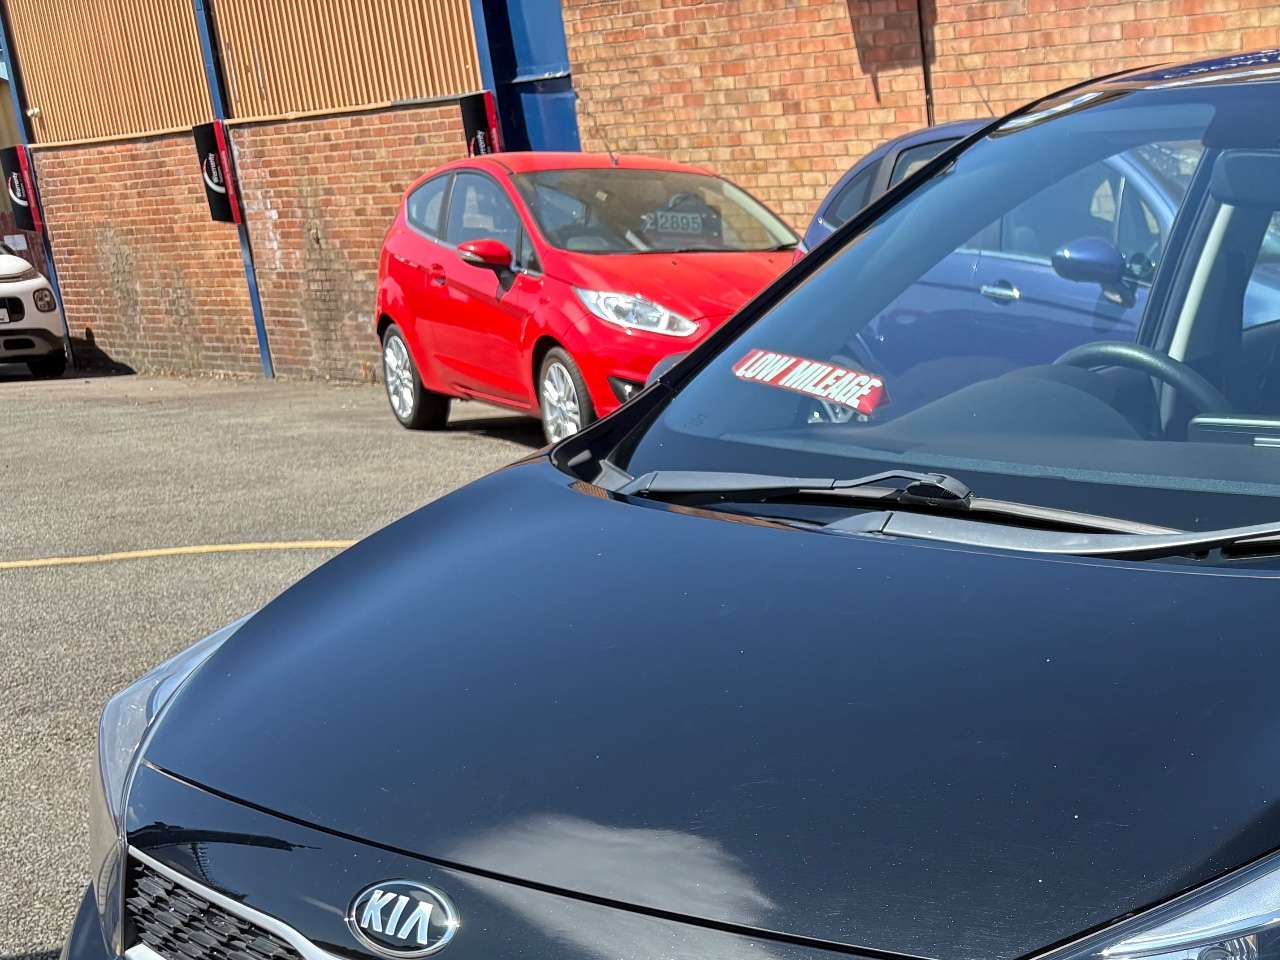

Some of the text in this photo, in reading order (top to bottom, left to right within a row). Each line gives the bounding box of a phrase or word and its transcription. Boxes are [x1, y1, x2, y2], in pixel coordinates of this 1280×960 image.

[12, 171, 22, 198] Warranty
[660, 215, 701, 232] 2895
[735, 351, 883, 409] LOW MILEAGE
[360, 889, 433, 945] KIA
